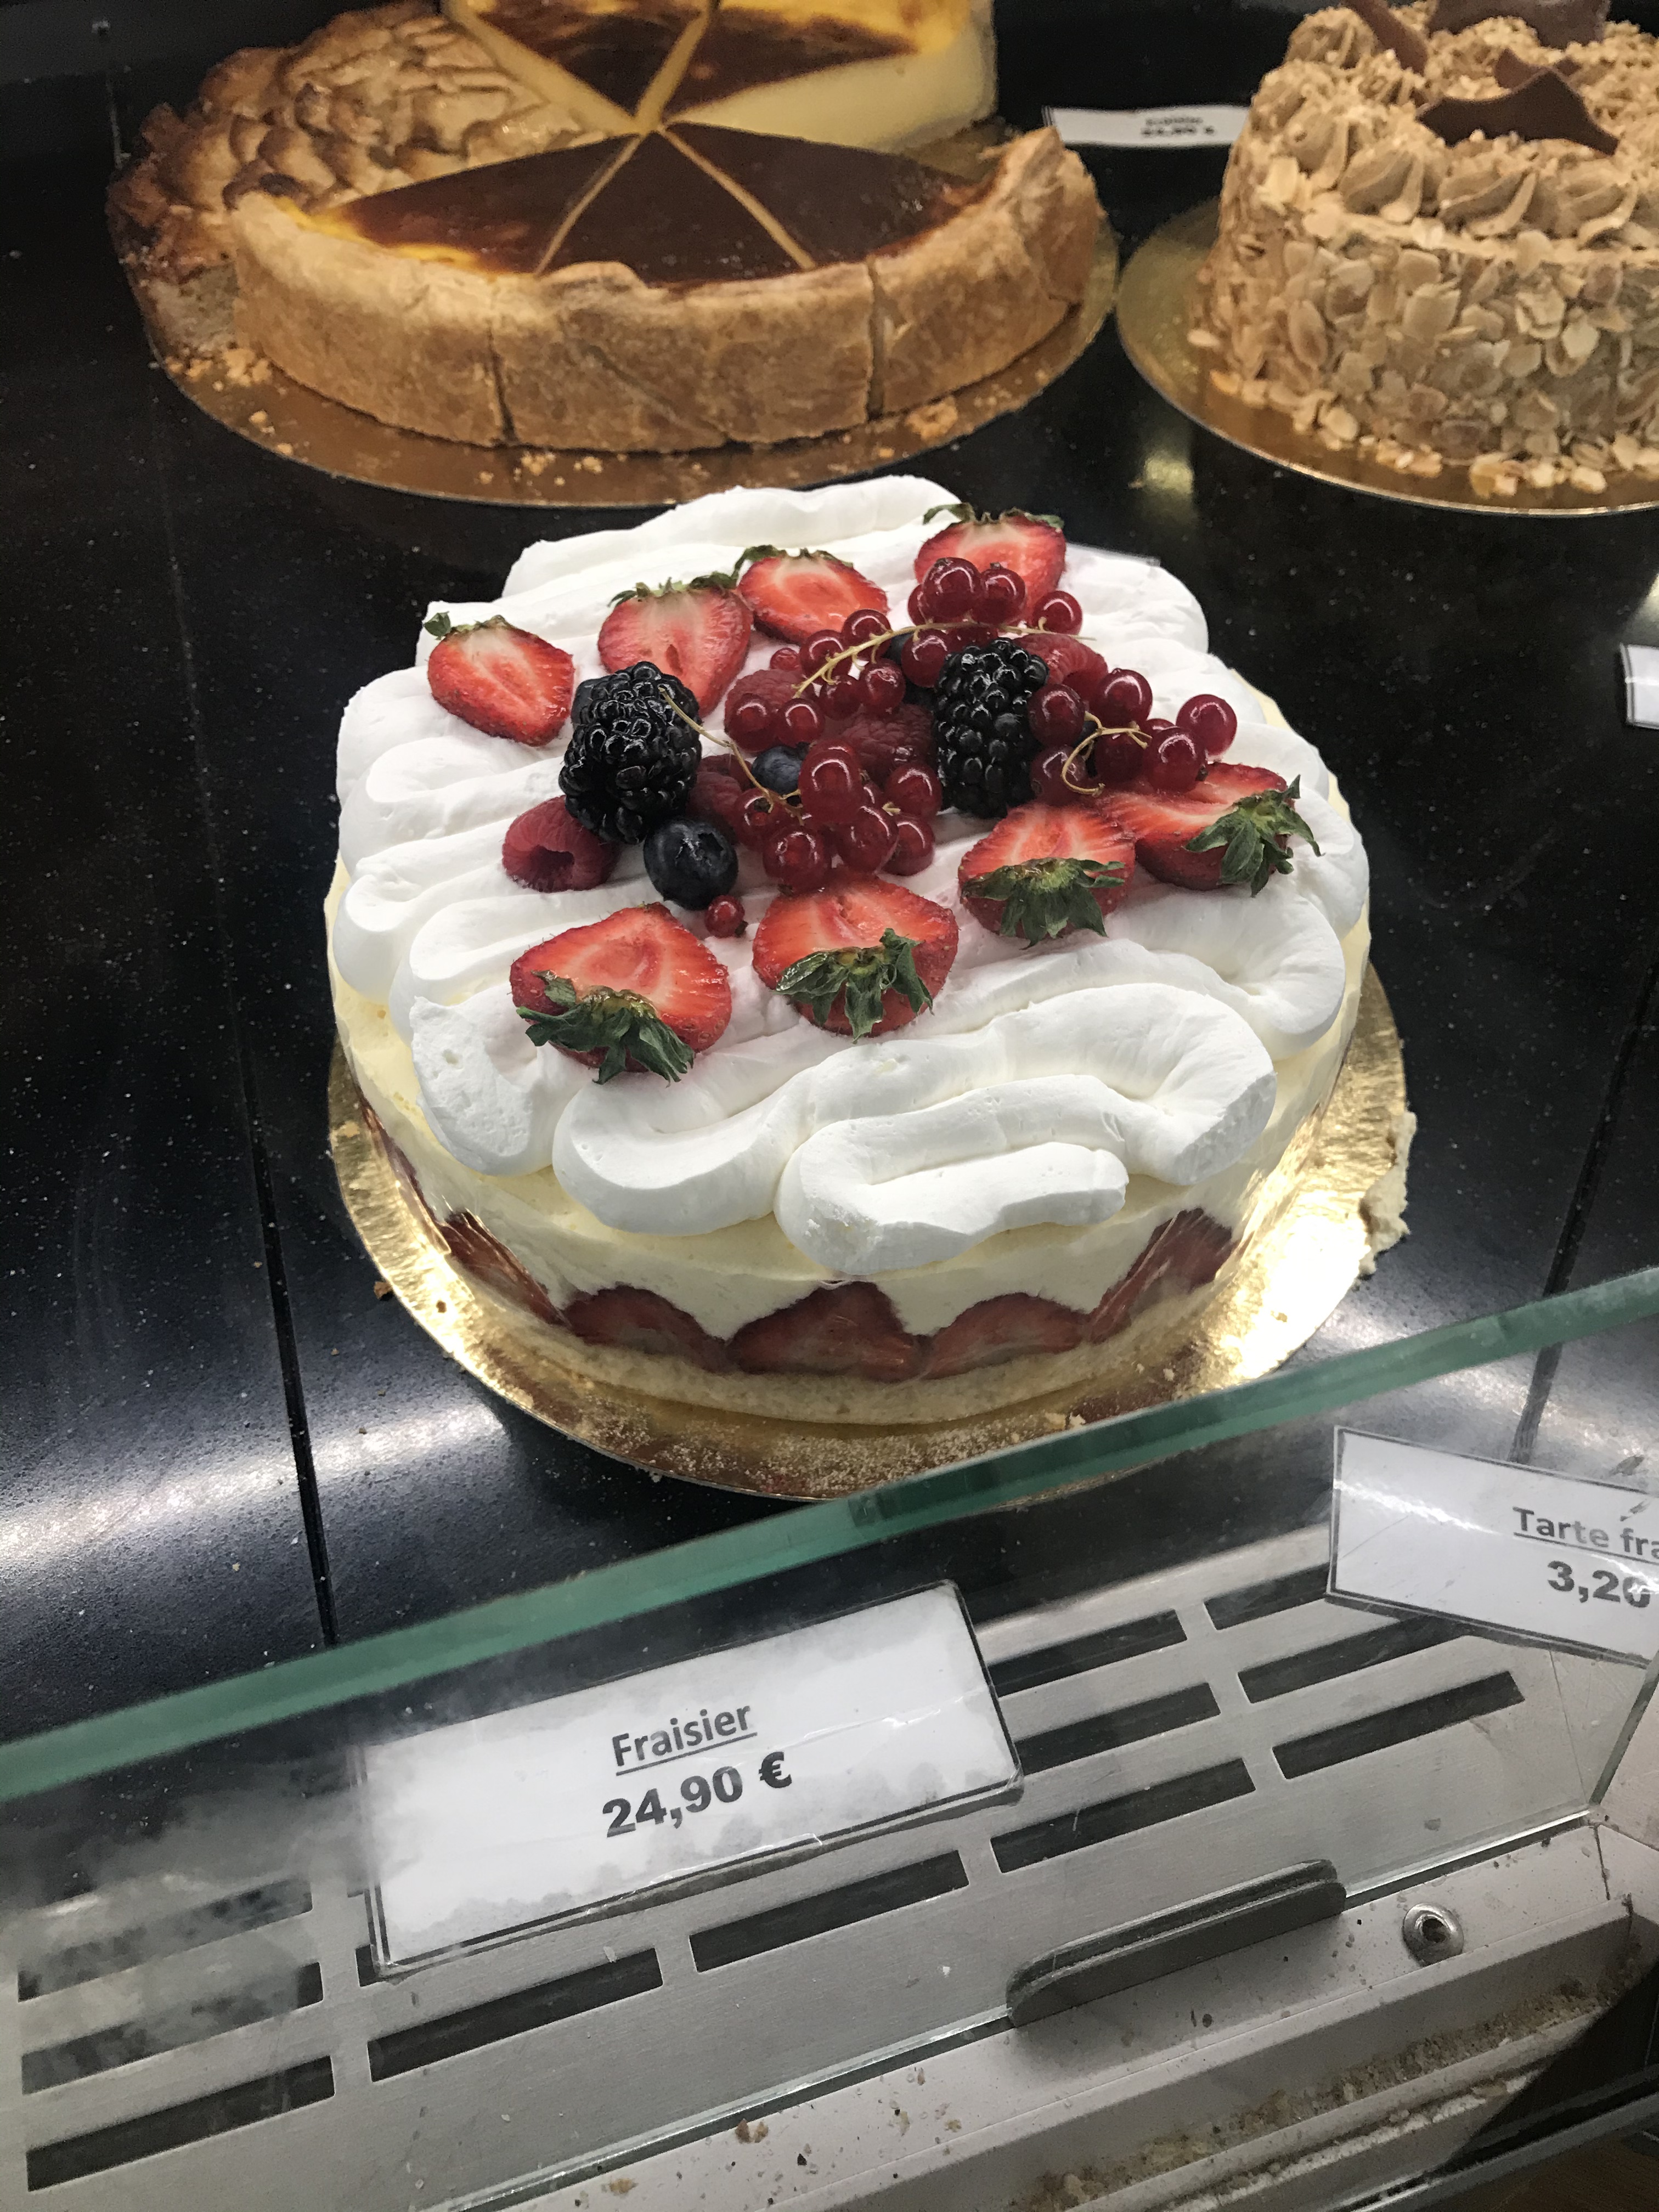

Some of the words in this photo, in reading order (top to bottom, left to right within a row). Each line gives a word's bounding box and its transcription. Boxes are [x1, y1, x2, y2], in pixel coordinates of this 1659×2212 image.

[1513, 1506, 1609, 1548] Tarte
[1547, 1560, 1651, 1608] 3,20
[612, 1706, 751, 1766] Fraisier
[602, 1766, 743, 1837] 24,90
[758, 1751, 792, 1788] €
